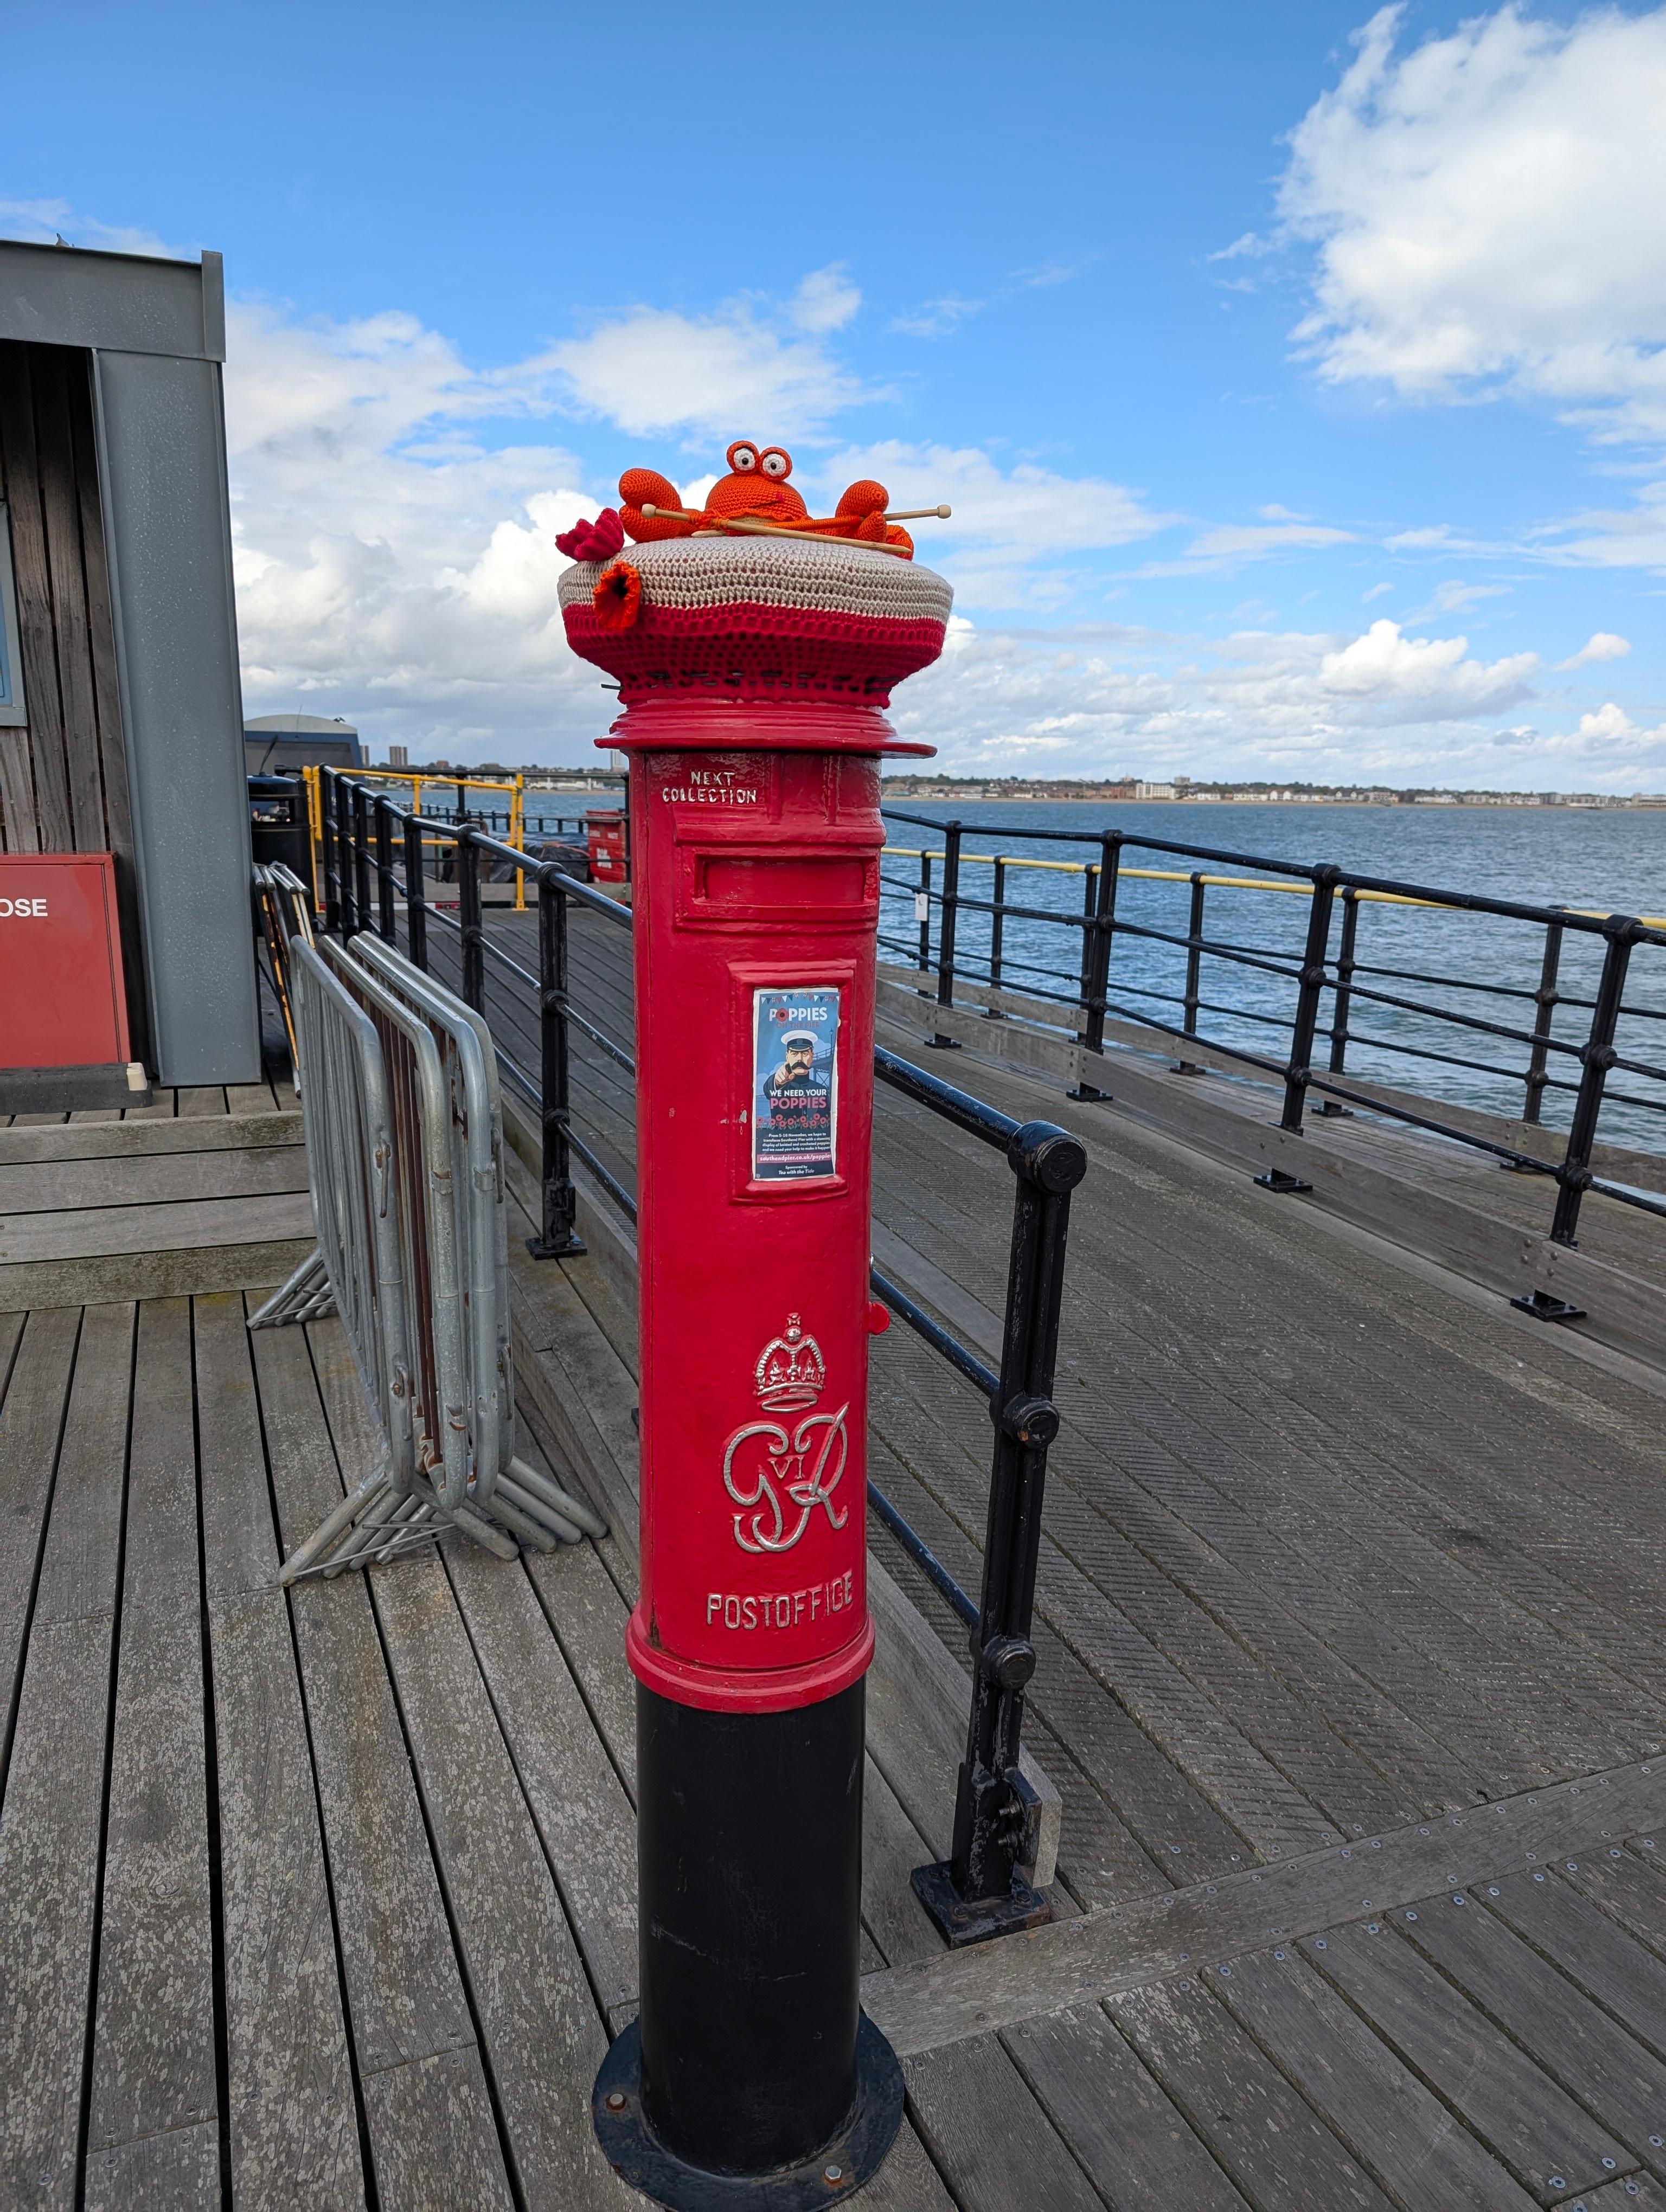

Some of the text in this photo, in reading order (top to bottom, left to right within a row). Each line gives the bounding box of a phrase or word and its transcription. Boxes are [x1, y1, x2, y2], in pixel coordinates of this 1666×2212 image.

[691, 771, 736, 786] NEXT
[662, 787, 757, 805] COLLECTION
[0, 898, 48, 917] OSE
[770, 1096, 826, 1109] POPPIES
